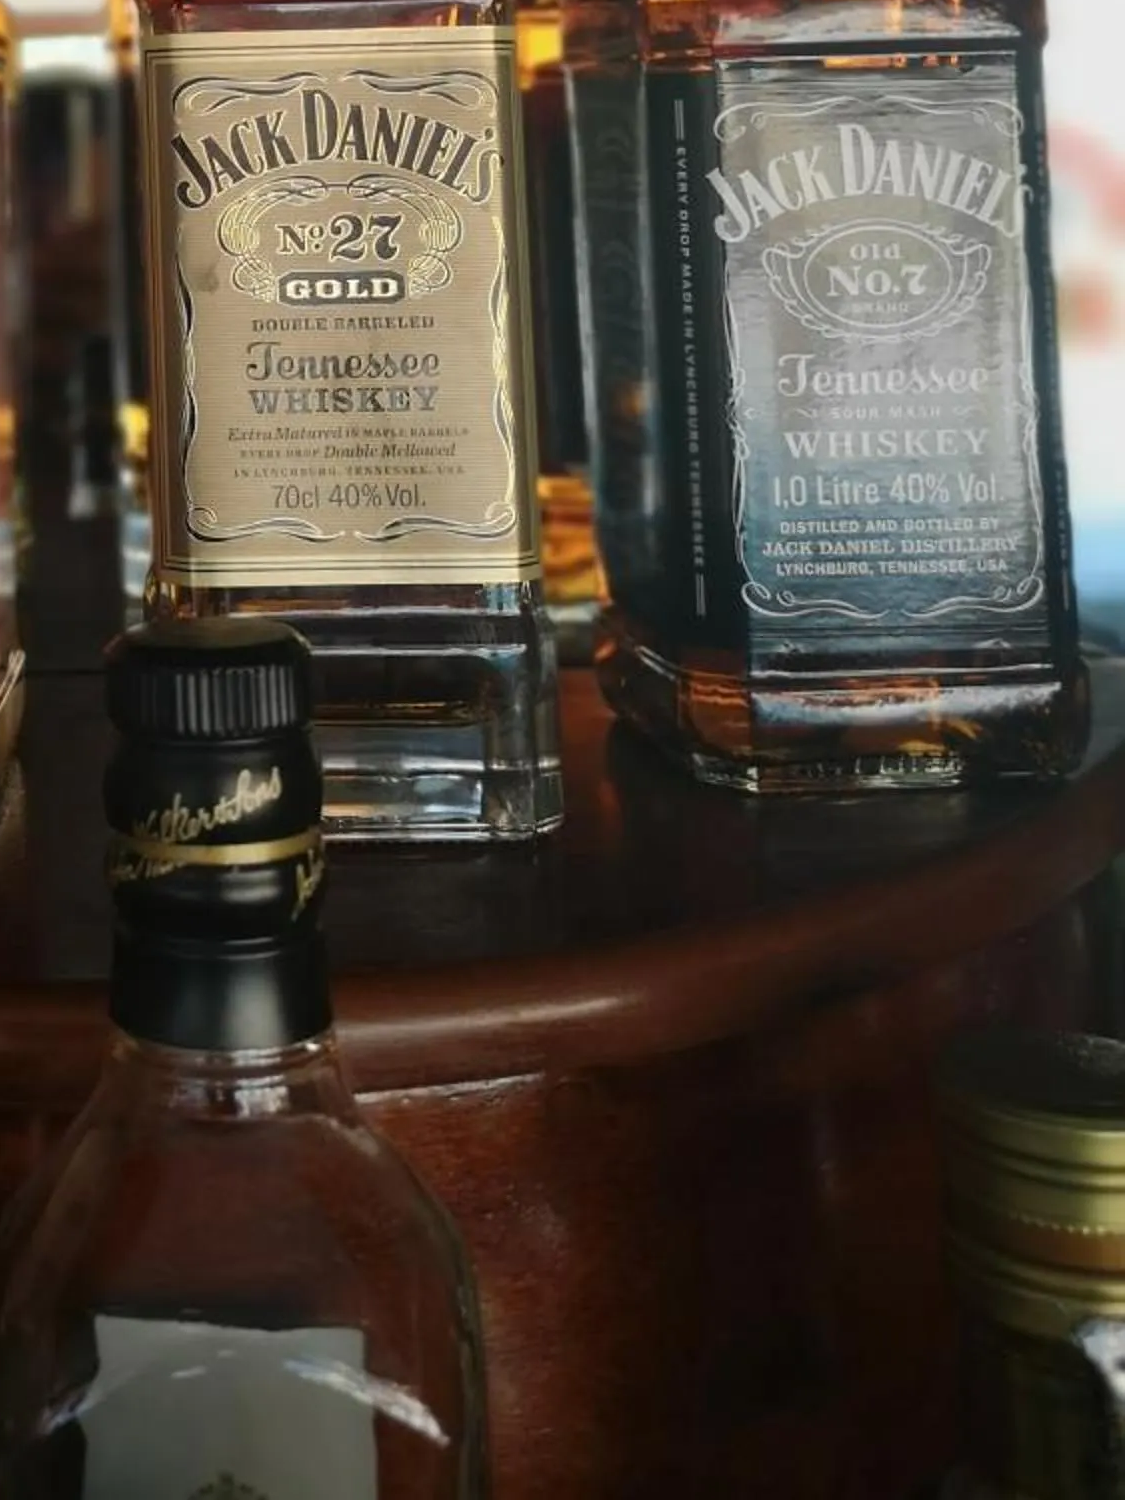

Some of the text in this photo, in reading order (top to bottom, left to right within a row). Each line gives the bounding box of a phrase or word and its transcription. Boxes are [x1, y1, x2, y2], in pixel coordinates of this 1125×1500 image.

[171, 88, 505, 211] JACK DANIEL'S
[705, 122, 1034, 244] JACK DANIEL'S
[849, 241, 901, 263] Old
[286, 277, 399, 300] GOLD
[681, 263, 694, 315] MADE
[826, 263, 928, 298] No.7
[252, 318, 328, 332] DOUBLE
[245, 341, 441, 381] Tennessee
[776, 353, 990, 397] Tennessee
[248, 386, 439, 414] WHISKEY
[783, 429, 989, 459] WHISKEY
[271, 482, 426, 509] 70cl 40% Vol.
[817, 475, 881, 506] Litre
[889, 473, 950, 504] 40%
[780, 520, 859, 534] DISTILLED
[864, 519, 897, 533] AND
[979, 517, 999, 531] BY
[762, 541, 814, 557] JACK
[818, 539, 895, 556] DANIEL
